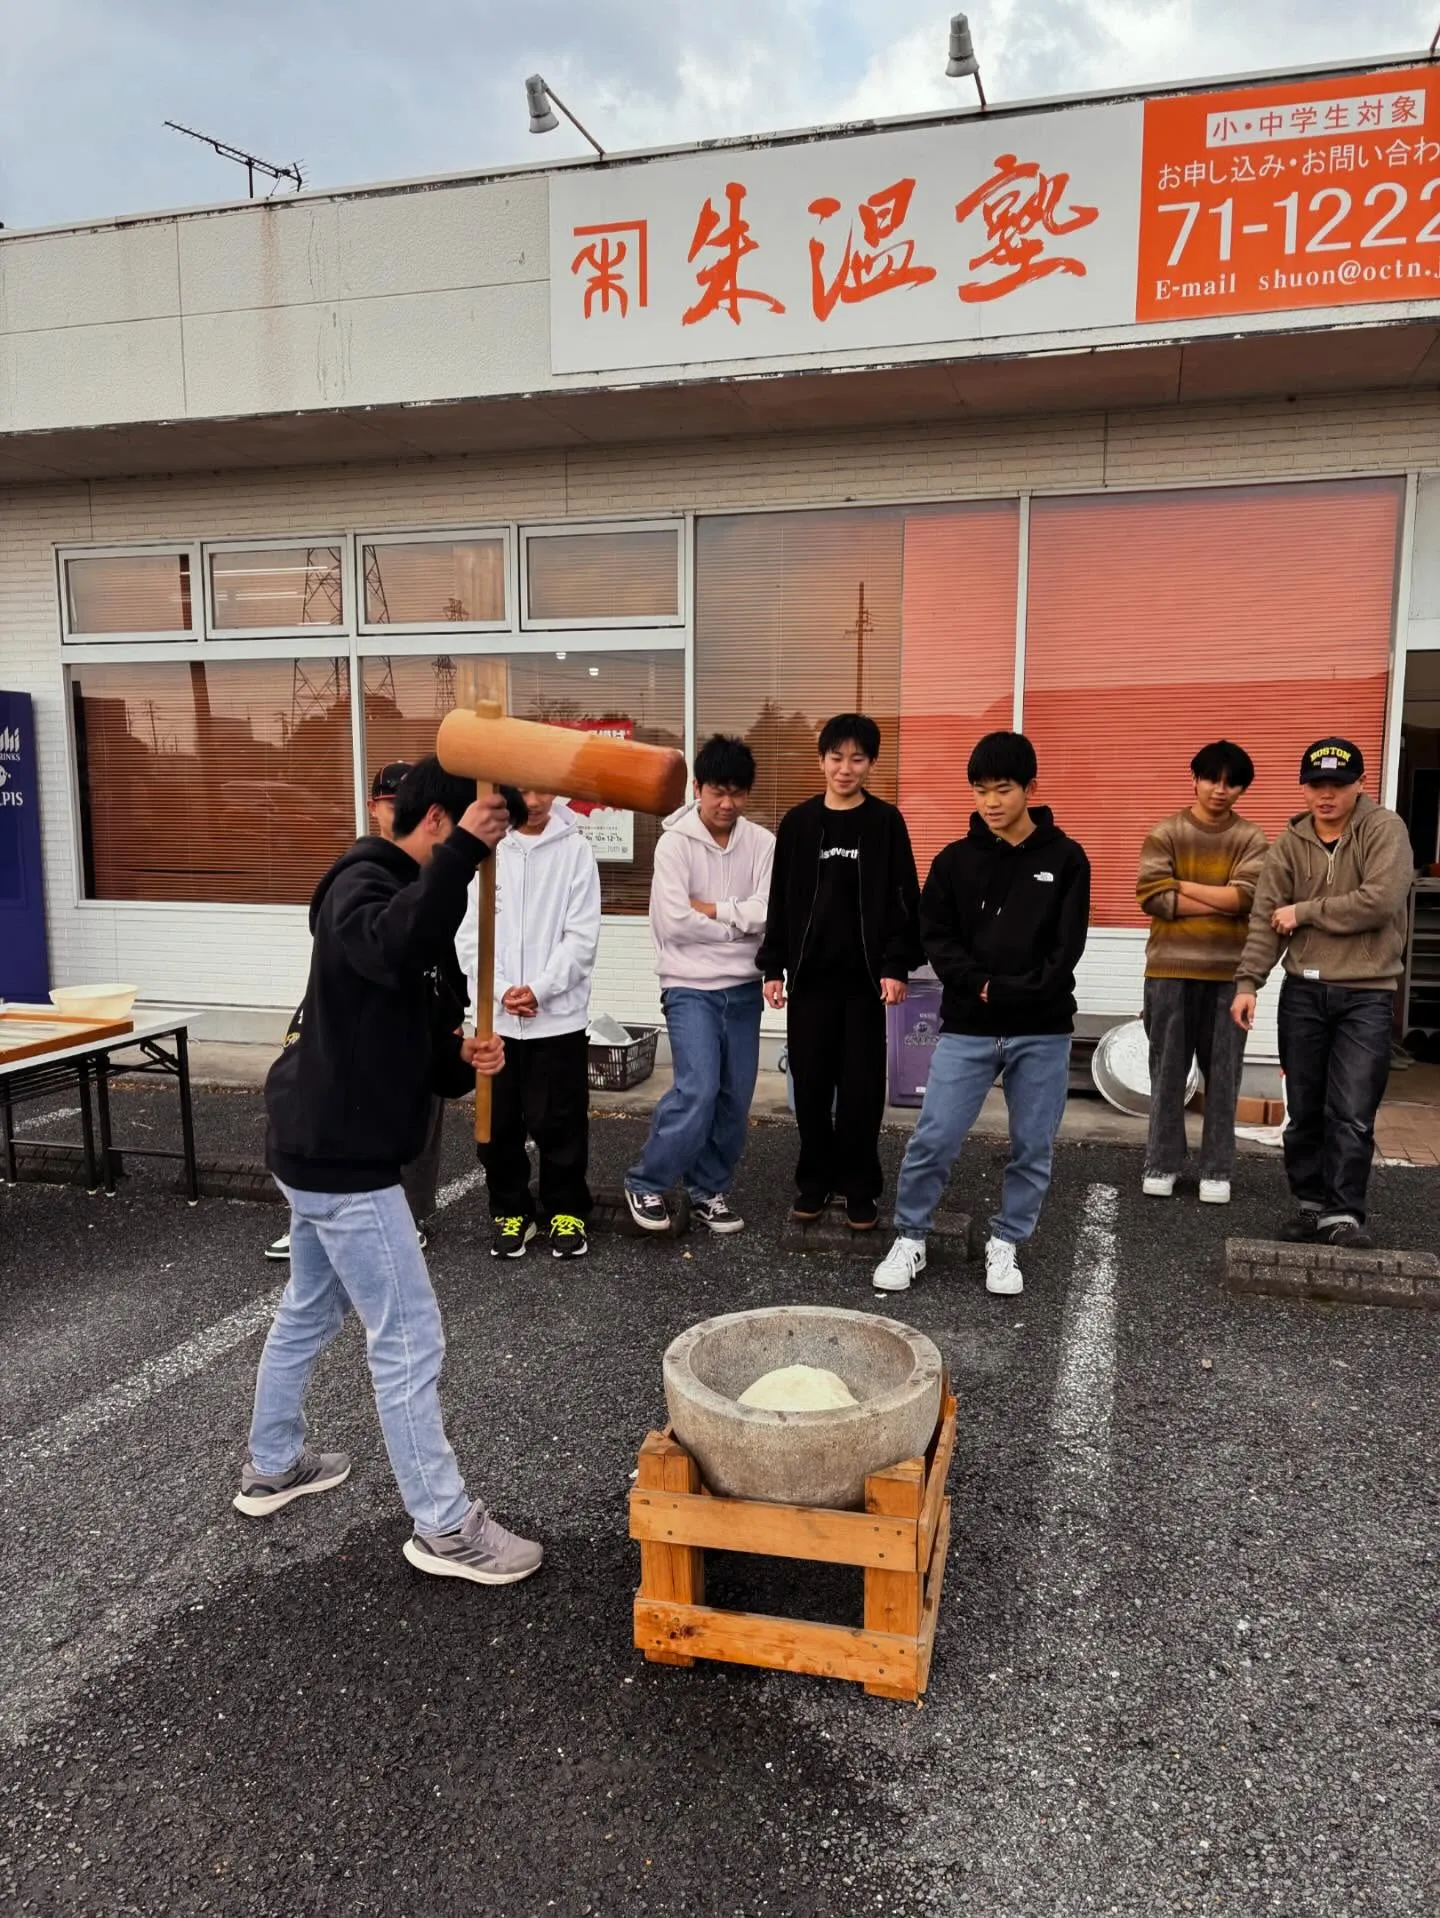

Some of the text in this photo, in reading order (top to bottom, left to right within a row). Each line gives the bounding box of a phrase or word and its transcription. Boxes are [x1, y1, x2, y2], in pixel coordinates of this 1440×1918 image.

[1212, 95, 1418, 142] 小・中学生対象
[1155, 274, 1237, 301] E-mail
[1310, 747, 1351, 762] BOSTON
